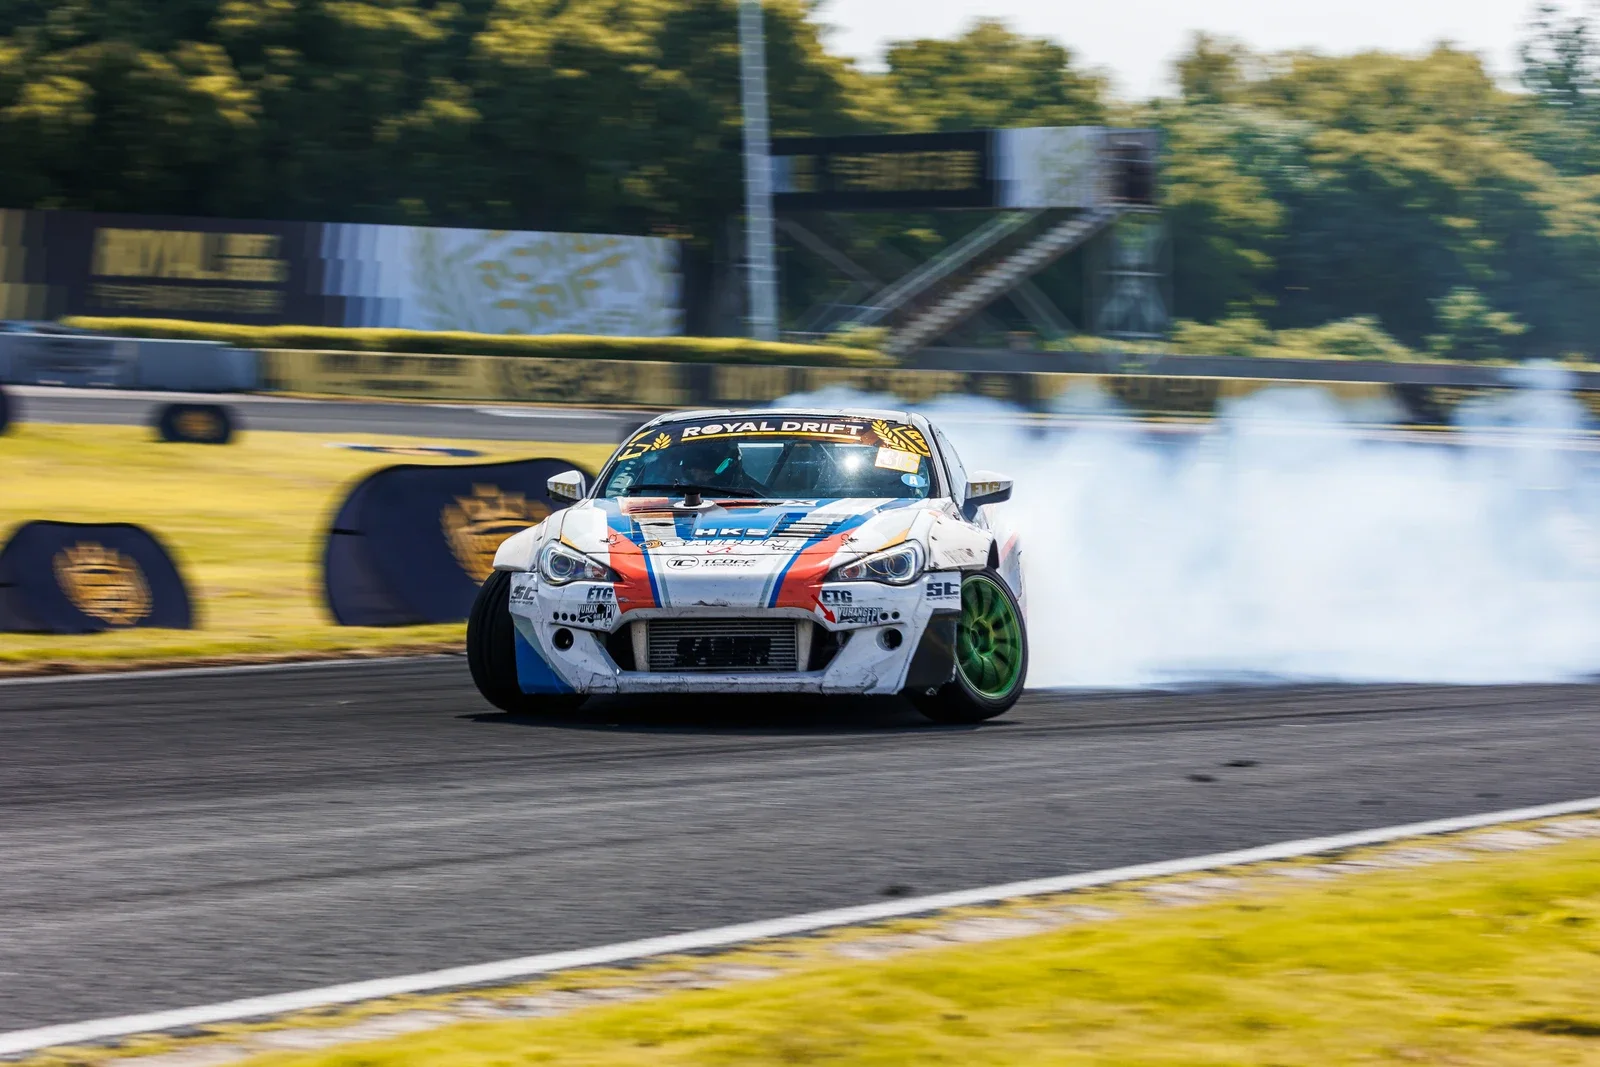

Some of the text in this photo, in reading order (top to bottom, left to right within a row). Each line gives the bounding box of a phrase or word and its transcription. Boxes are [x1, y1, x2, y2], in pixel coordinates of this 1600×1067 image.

[682, 421, 863, 437] ROYAL DRIFT
[694, 528, 769, 536] HKS
[587, 587, 614, 601] ETG
[821, 589, 853, 604] ETG
